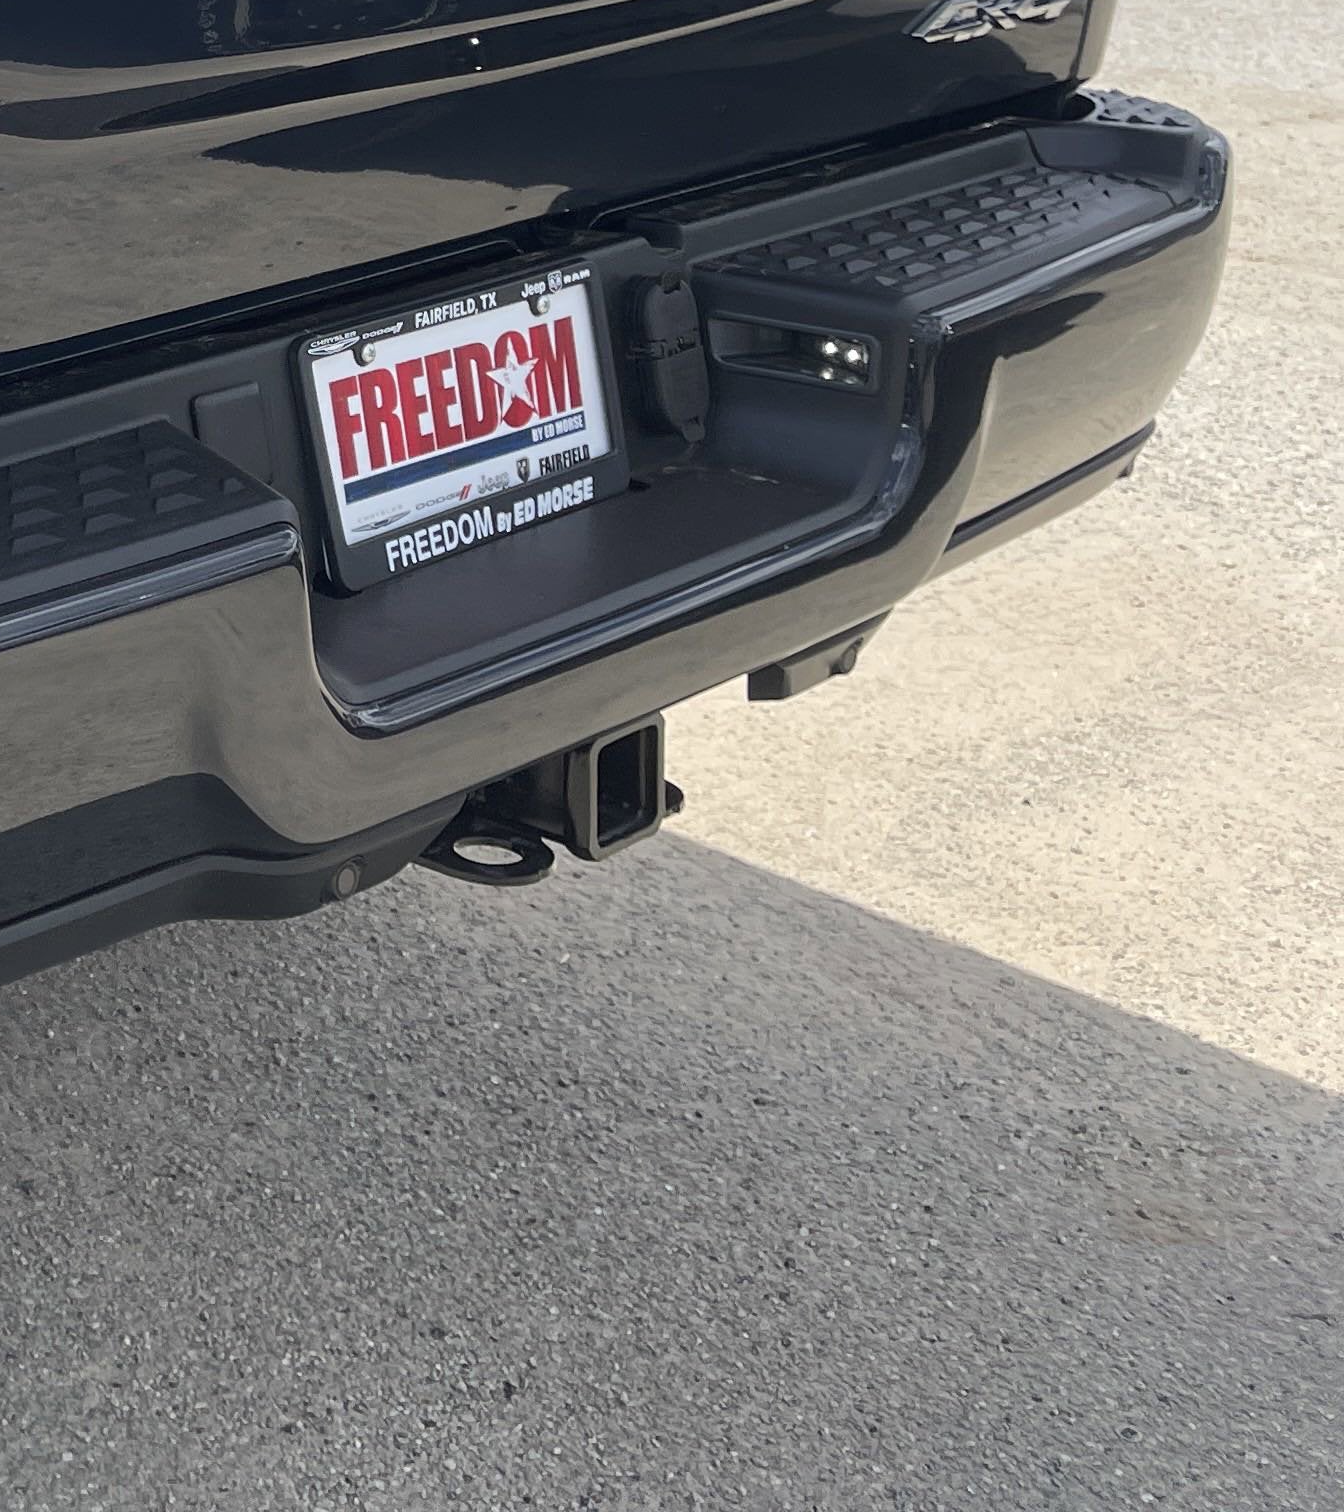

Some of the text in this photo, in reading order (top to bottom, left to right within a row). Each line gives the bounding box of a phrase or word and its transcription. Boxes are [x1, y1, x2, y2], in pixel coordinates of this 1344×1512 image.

[310, 330, 357, 348] CHRYSLER
[415, 297, 478, 328] FAIRFIELD,
[479, 292, 497, 310] TX
[521, 281, 546, 298] Jeep
[563, 269, 591, 284] RAM
[329, 316, 583, 480] FREEDOM
[532, 426, 544, 442] BY
[555, 414, 583, 435] MORSE
[538, 444, 591, 476] FAIRFIELD
[385, 506, 495, 572] FREEDOM
[513, 497, 535, 526] ED
[537, 476, 593, 517] MORSE
